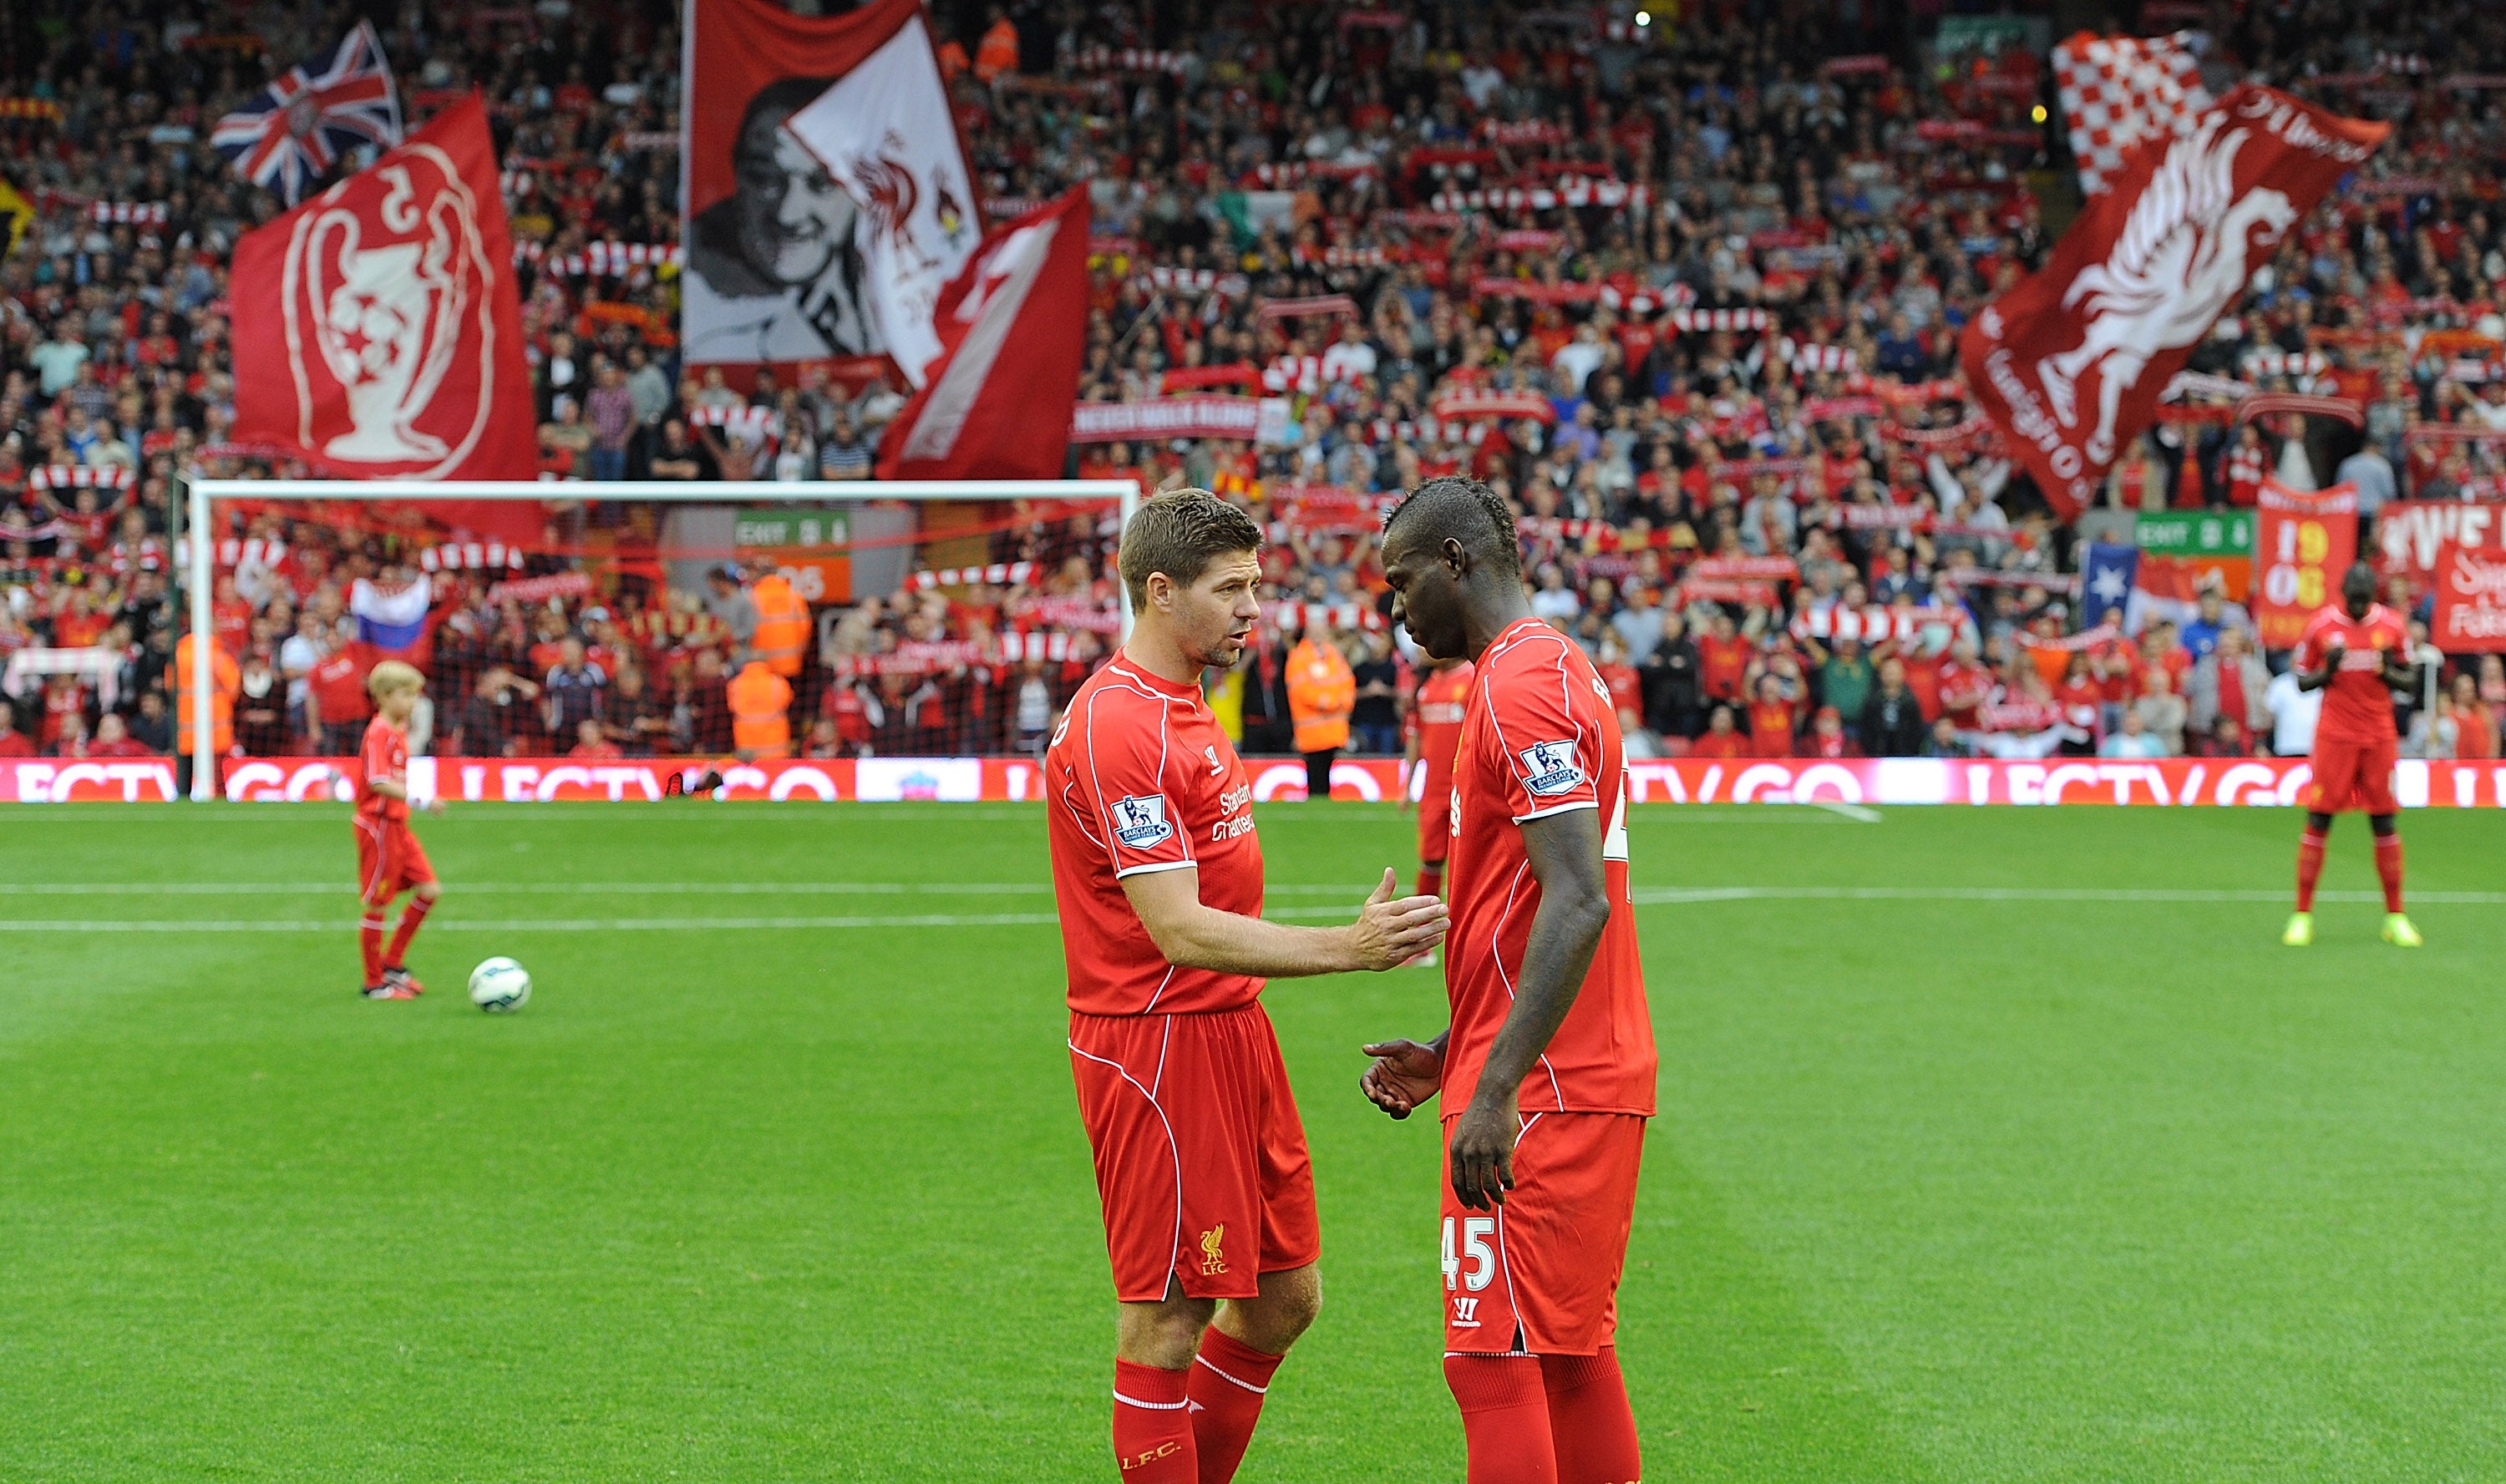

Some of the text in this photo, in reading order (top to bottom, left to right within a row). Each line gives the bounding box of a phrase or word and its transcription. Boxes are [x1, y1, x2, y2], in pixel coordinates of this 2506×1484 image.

[1537, 770, 1571, 786] BARCLAYS
[1124, 826, 1156, 838] BARCLAYS
[1442, 1218, 1495, 1291] 45
